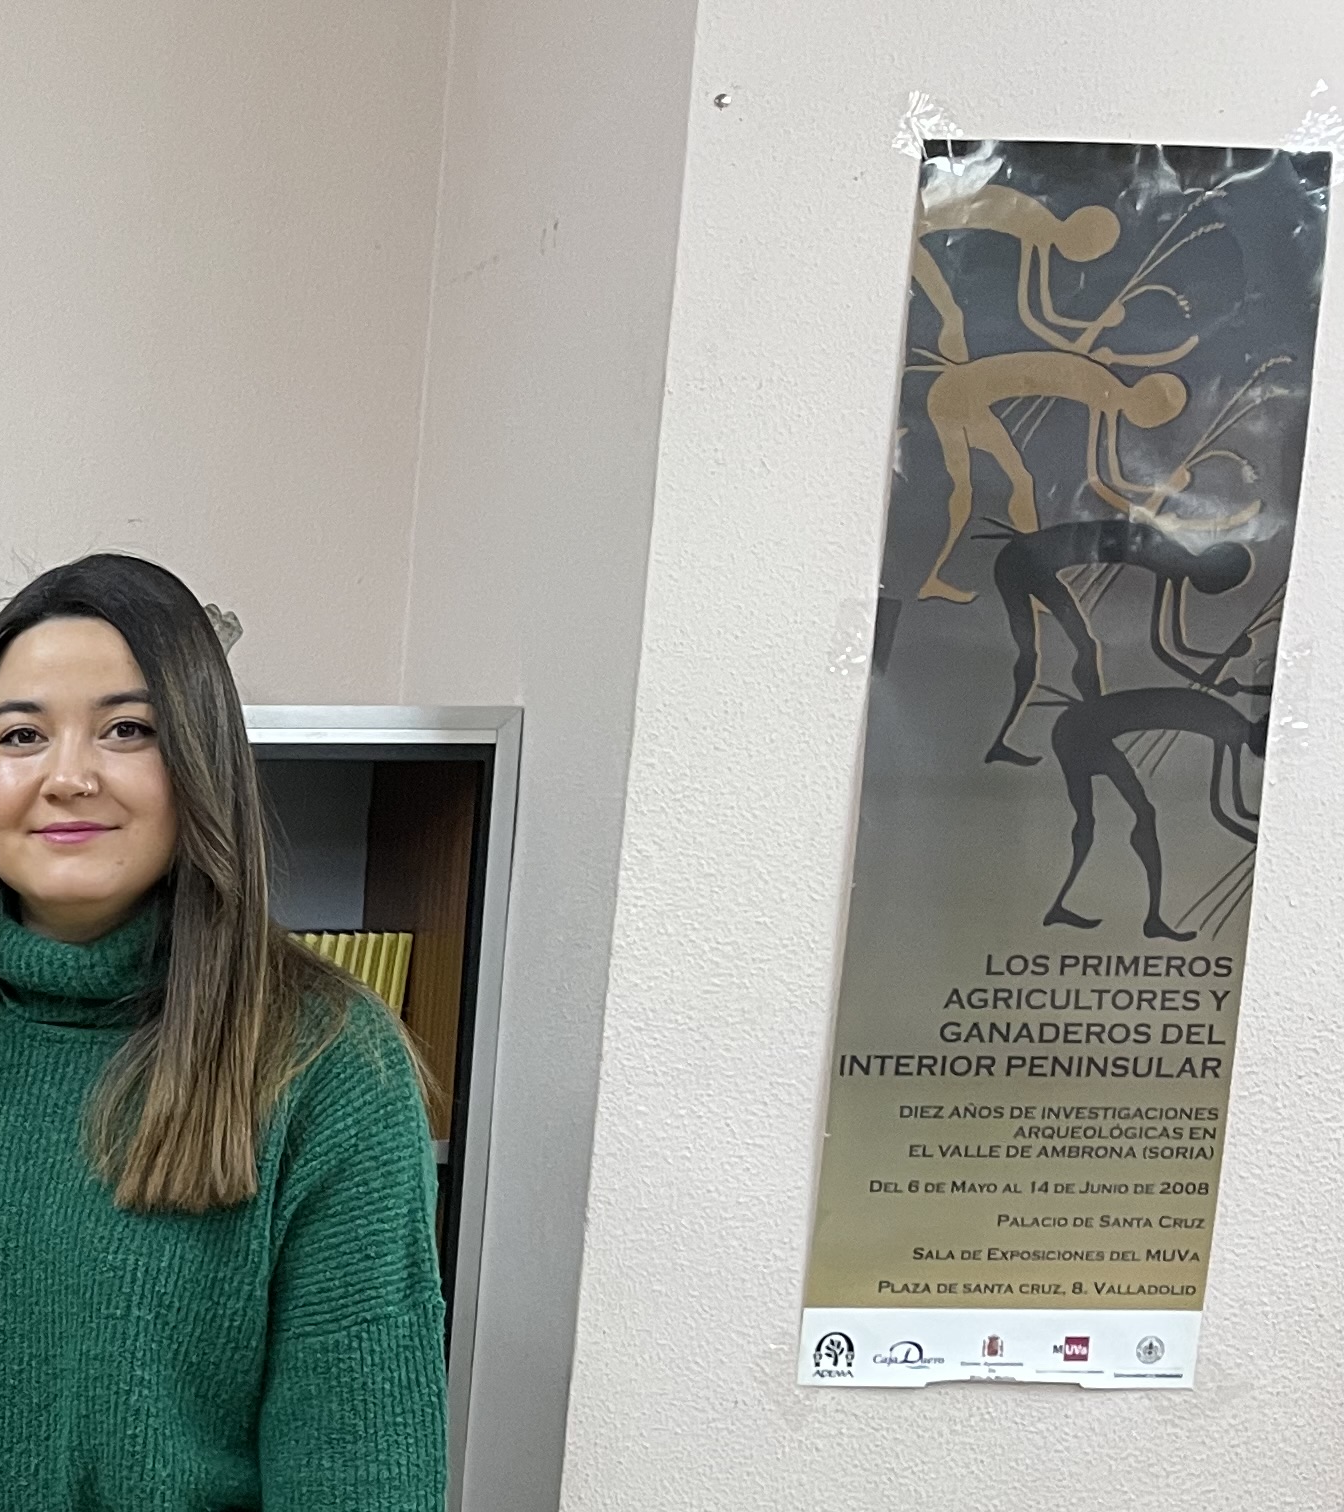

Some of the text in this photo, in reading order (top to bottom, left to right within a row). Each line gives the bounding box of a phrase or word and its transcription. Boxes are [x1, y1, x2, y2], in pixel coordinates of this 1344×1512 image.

[985, 953, 1233, 977] LOS PRIMEROS
[943, 988, 1231, 1011] AGRICULTORES Y
[939, 1021, 1226, 1045] GANADEROS DEL
[839, 1054, 1222, 1078] INTERIOR PENINSULAR
[899, 1102, 1219, 1121] DIEZ AÑOS DE INVESTIGACIONES
[1013, 1122, 1217, 1140] ARQUEOLÓGICAS EN
[908, 1144, 1215, 1161] EL VALLE DE AMBRONA (SORIA)
[907, 1179, 920, 1194] 6
[1030, 1181, 1049, 1194] 14
[1159, 1181, 1210, 1195] 2008
